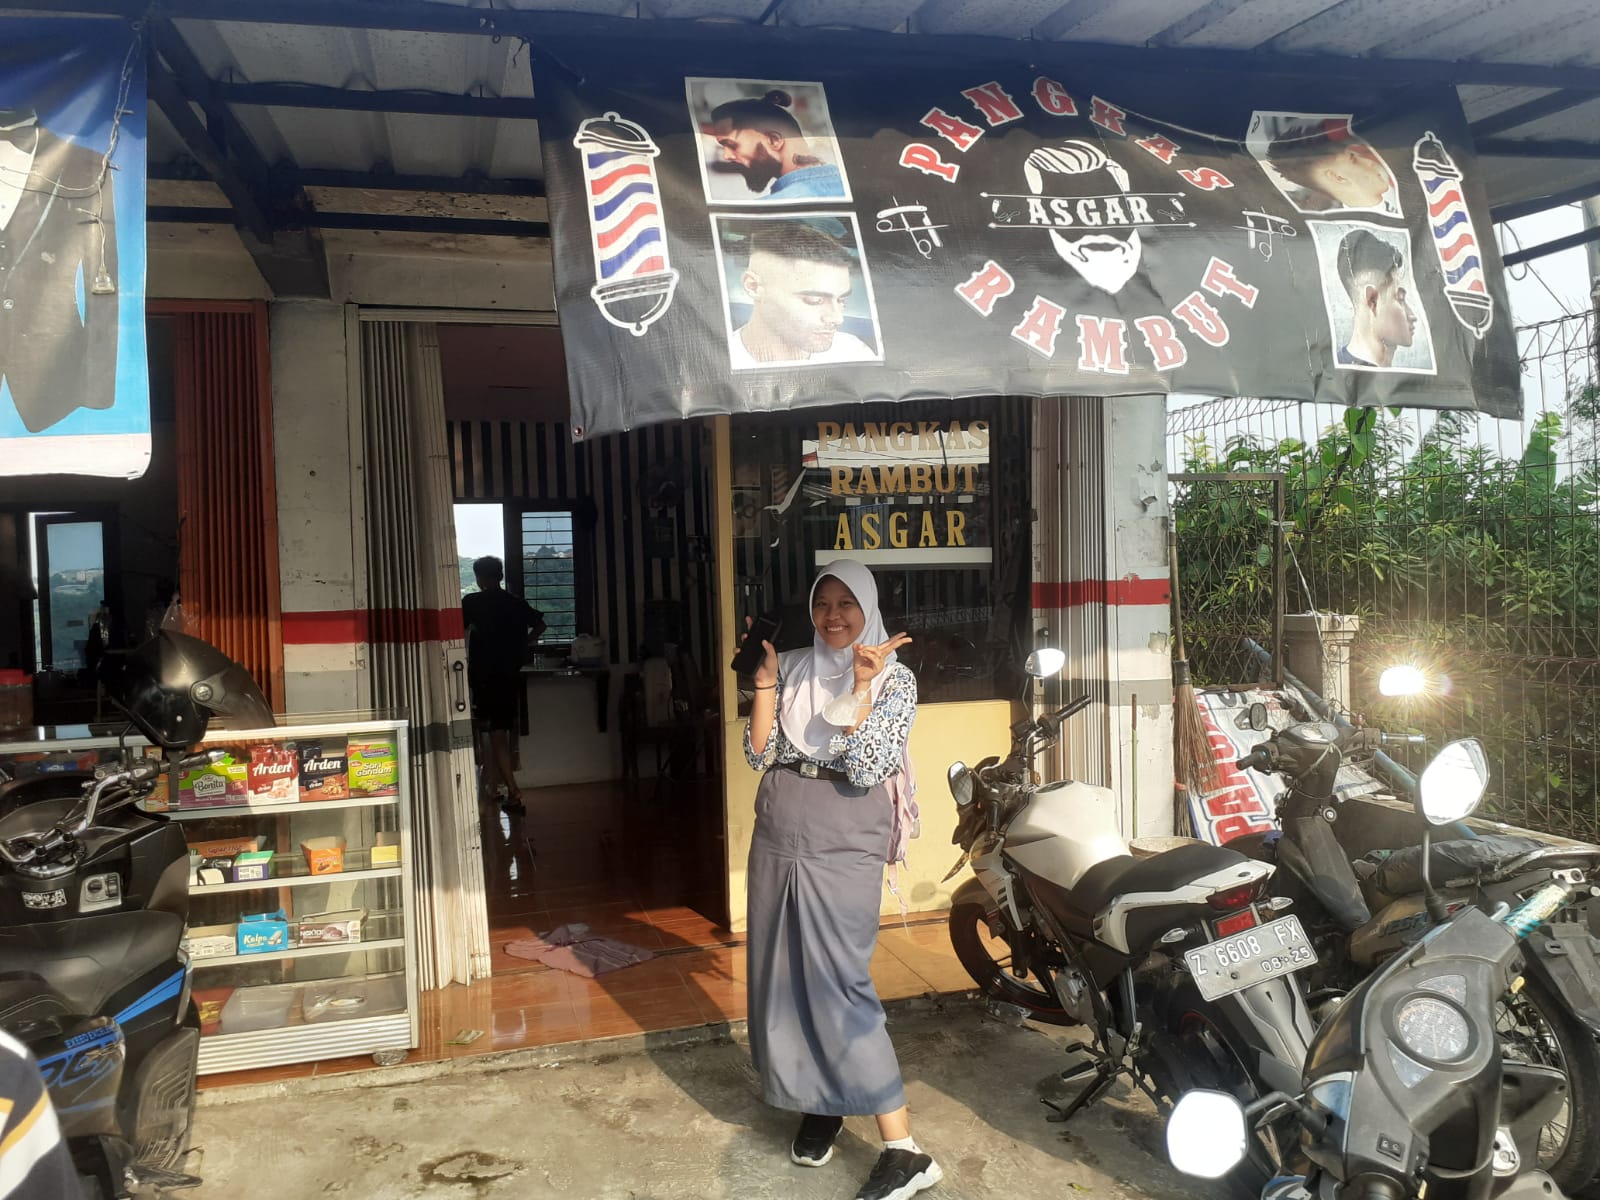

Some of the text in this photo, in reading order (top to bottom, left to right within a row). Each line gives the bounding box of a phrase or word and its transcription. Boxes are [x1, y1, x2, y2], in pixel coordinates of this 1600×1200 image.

[898, 76, 1235, 191] PANGKAS
[1028, 196, 1155, 226] ASGAR
[954, 256, 1260, 375] RAMBUT
[817, 420, 990, 452] PANGKAS
[830, 464, 979, 494] RAMBUT
[834, 510, 967, 551] ASGAR
[253, 762, 293, 777] Arden
[304, 758, 341, 773] Arden
[355, 767, 392, 777] Gandum
[195, 781, 224, 792] Bonita
[1190, 919, 1302, 976] Z 6608 FX
